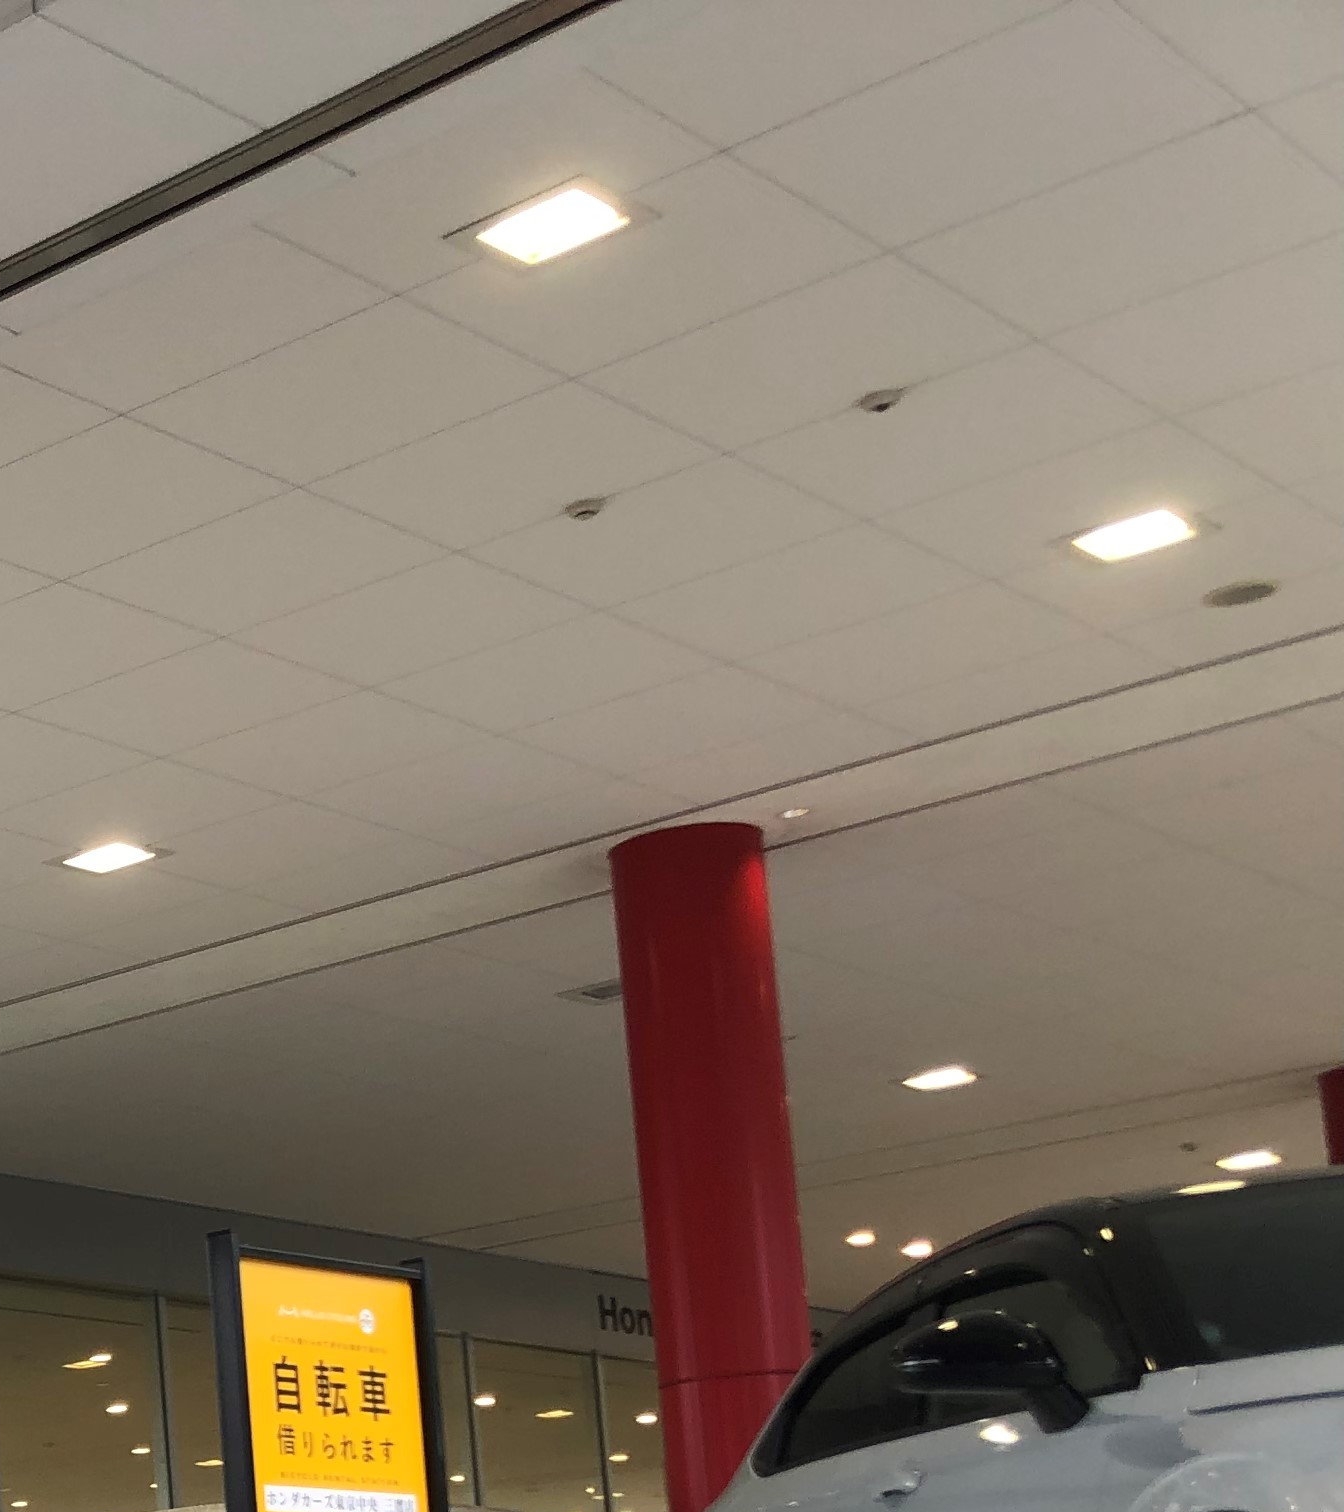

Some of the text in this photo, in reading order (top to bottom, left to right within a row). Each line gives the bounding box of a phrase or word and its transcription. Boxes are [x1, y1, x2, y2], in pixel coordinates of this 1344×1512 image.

[596, 1293, 653, 1337] Hon
[273, 1355, 391, 1421] 自転車
[277, 1424, 394, 1464] 借りられます
